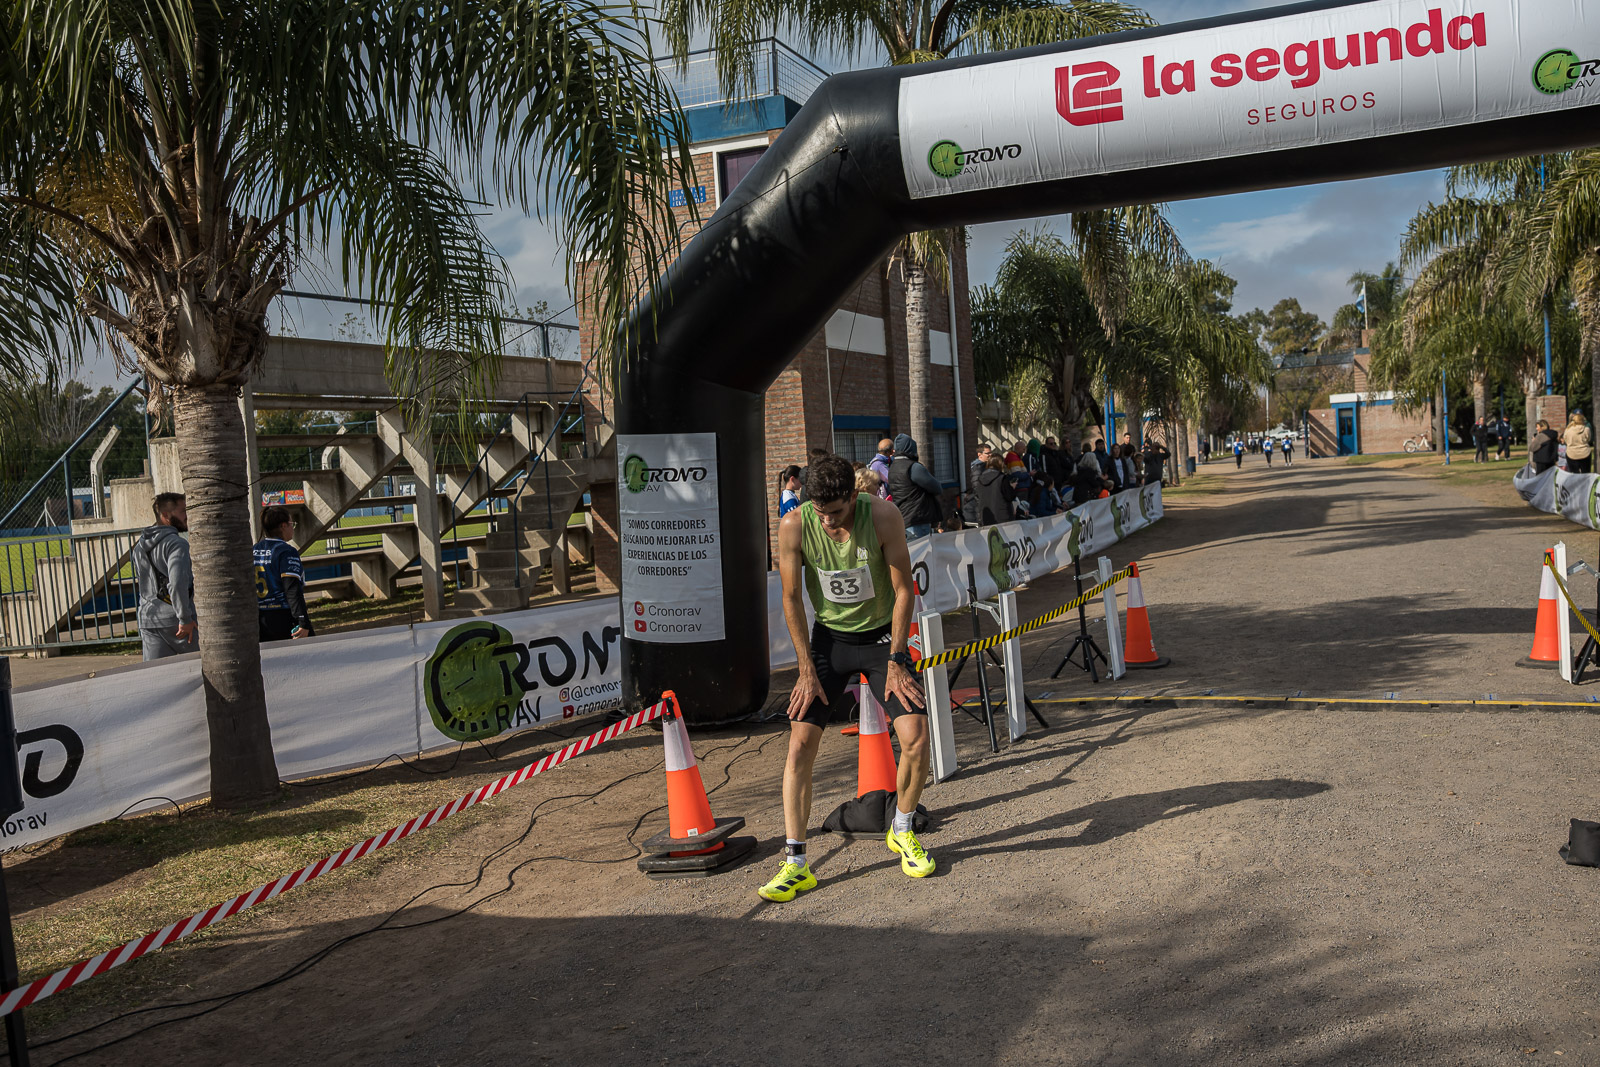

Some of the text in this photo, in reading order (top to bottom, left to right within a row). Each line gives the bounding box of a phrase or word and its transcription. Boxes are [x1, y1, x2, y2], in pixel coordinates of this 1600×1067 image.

[1143, 8, 1487, 98] la segunda
[1563, 78, 1596, 92] RAV
[1247, 91, 1376, 126] SEGUROS
[954, 144, 1022, 166] CRONO
[954, 166, 978, 176] RAV
[639, 466, 708, 483] CRONO
[639, 484, 661, 493] RAV
[651, 519, 706, 530] CORREDORES
[656, 534, 697, 545] MEJORAR
[698, 533, 715, 544] LAS
[627, 549, 707, 561] EXPERIENCIAS DE LOS
[830, 578, 860, 596] 83
[648, 605, 702, 617] Cronorav
[649, 621, 702, 633] Cronorav
[571, 681, 621, 701] @cronor
[495, 695, 542, 731] RAV
